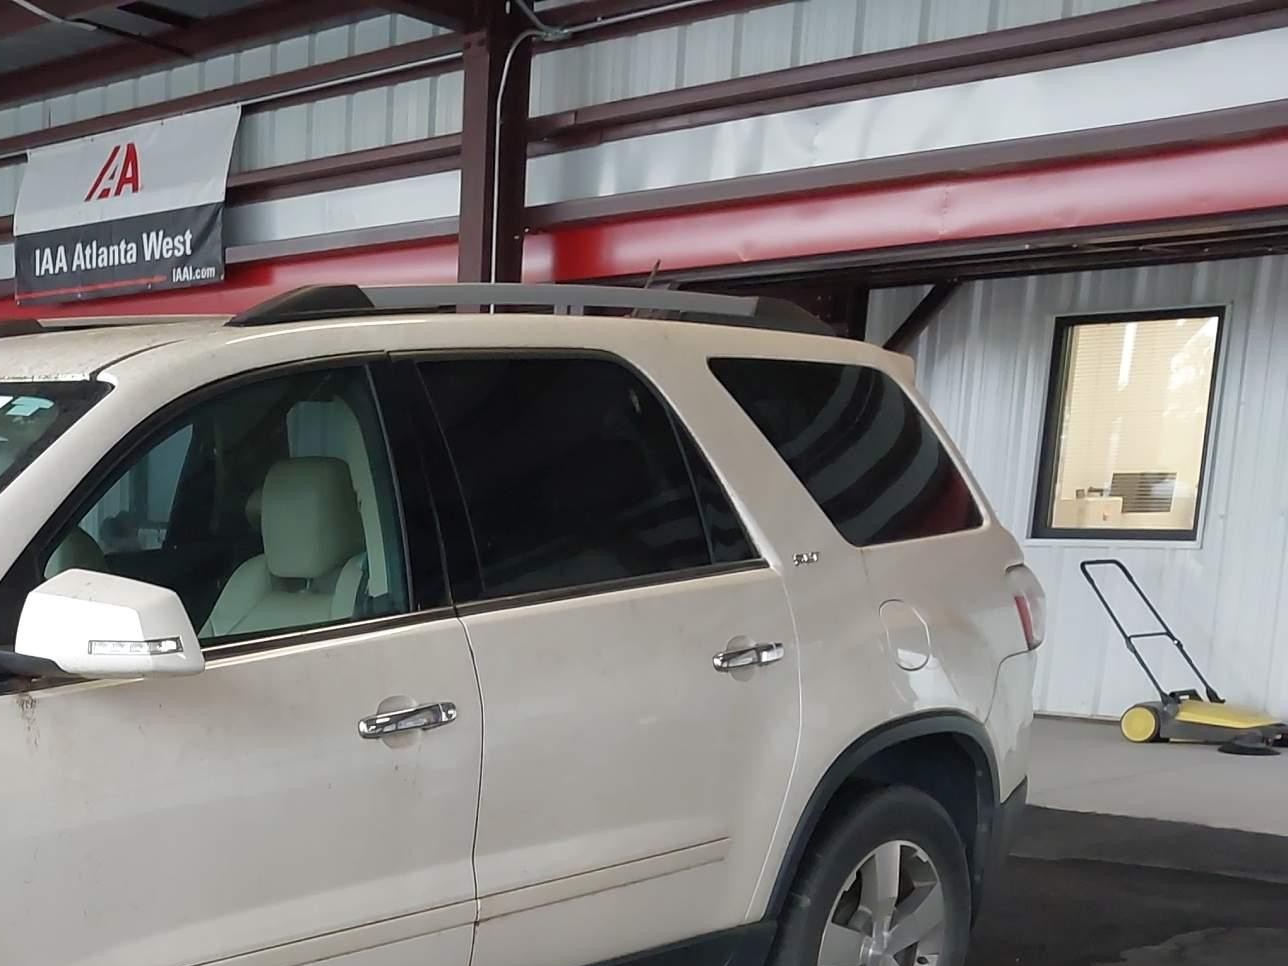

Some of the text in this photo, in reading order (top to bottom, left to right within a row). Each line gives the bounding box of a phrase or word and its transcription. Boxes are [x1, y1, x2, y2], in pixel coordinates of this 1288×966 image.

[35, 228, 193, 277] IAA Atlanta West
